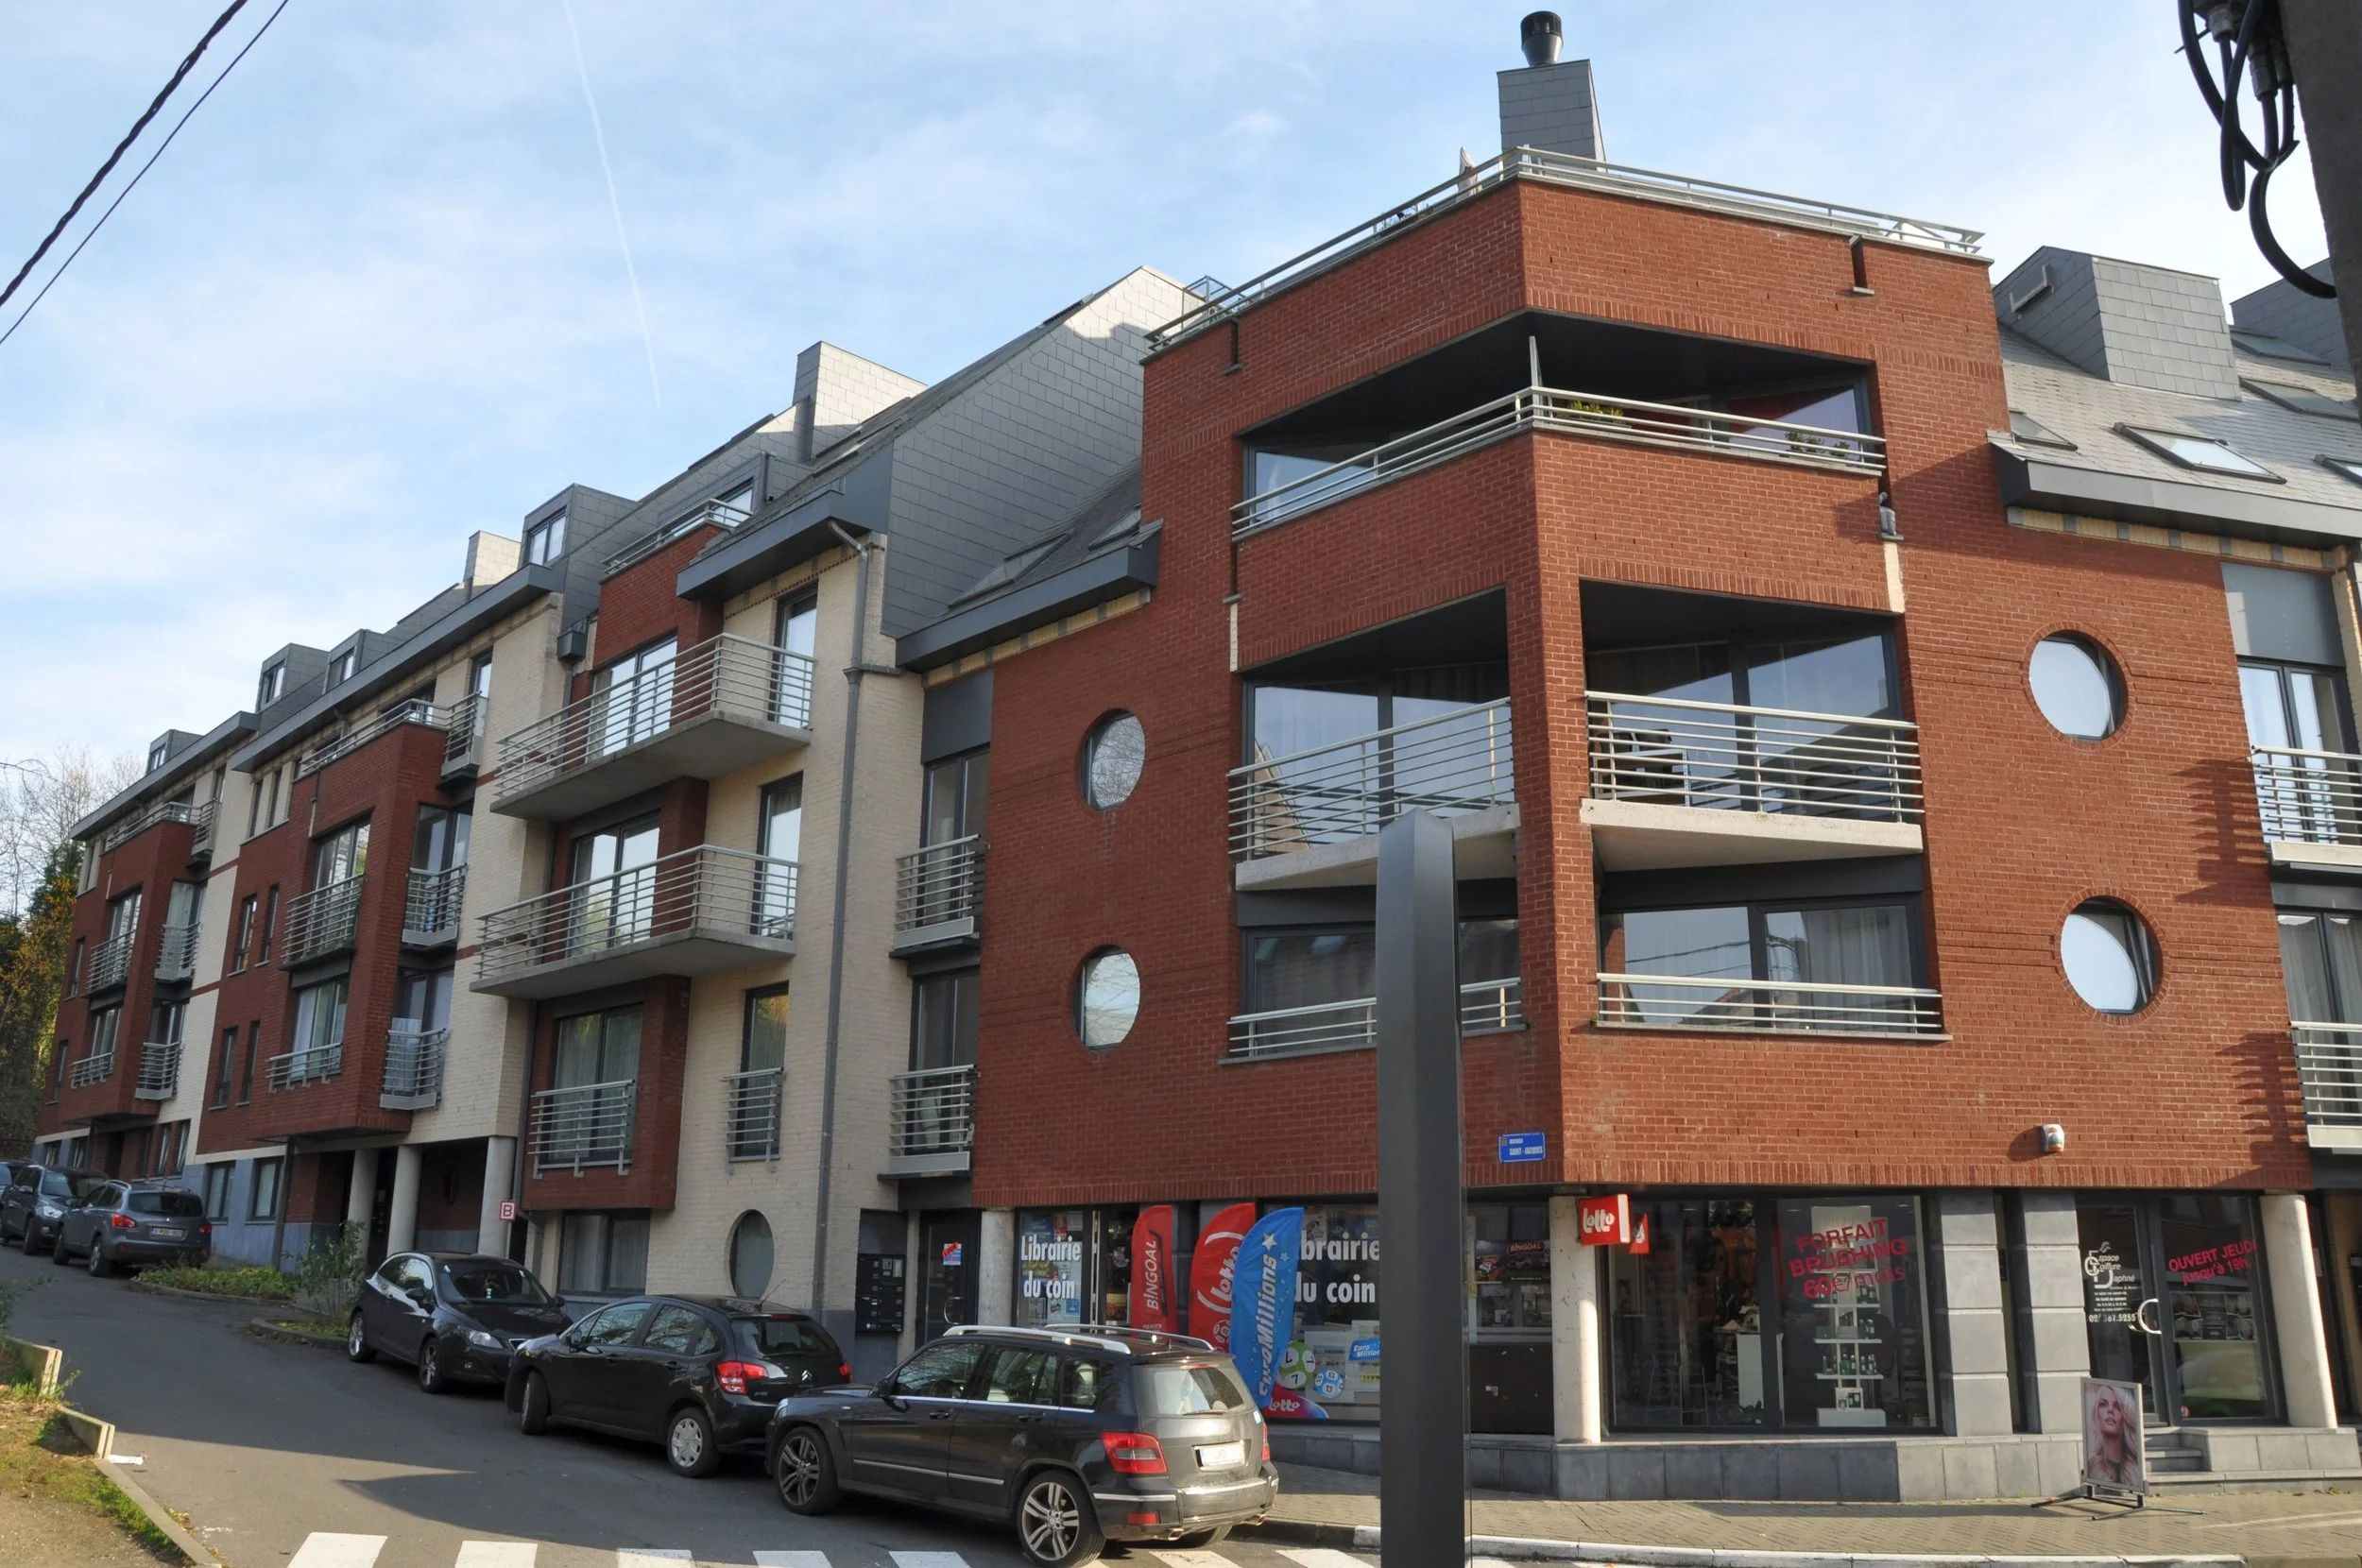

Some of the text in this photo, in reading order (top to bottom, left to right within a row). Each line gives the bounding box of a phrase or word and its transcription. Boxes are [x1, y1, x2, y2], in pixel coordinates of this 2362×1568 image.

[503, 1204, 513, 1218] B
[1020, 1235, 1082, 1262] Librairie
[1299, 1230, 1380, 1261] brairie
[1796, 1218, 1889, 1254] FORFAIT
[1789, 1237, 1908, 1278] BRUSHING
[2168, 1248, 2218, 1272] OUVERT
[1023, 1270, 1076, 1300] du coin
[2182, 1262, 2227, 1286] jusqu'à
[1326, 1273, 1377, 1304] coin
[1356, 1350, 1380, 1358] Million
